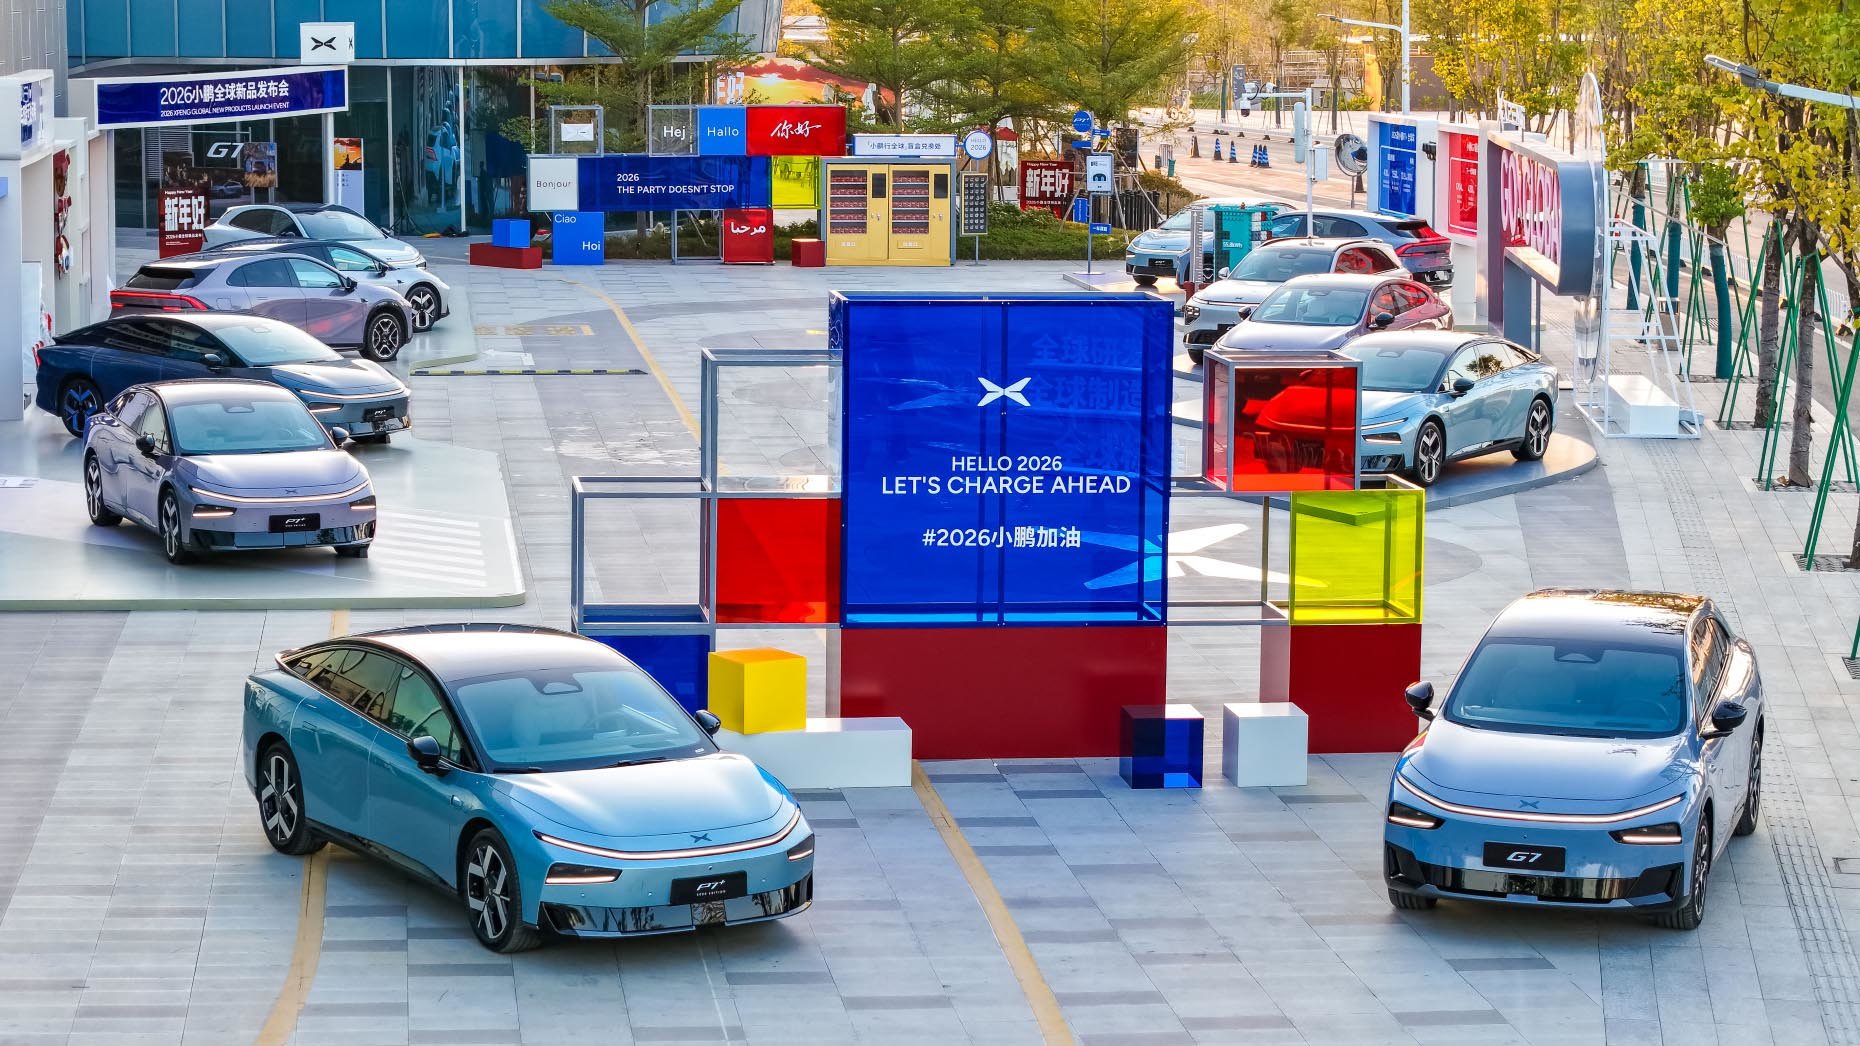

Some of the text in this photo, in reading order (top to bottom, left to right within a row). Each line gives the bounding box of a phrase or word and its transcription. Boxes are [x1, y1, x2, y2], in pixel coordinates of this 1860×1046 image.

[160, 79, 289, 105] 2026小鹏全球新品发布会
[192, 107, 212, 115] GLOBAL
[212, 106, 225, 114] NEW
[225, 105, 251, 113] PRODUCTS
[252, 103, 273, 111] LAUNCH
[663, 125, 686, 141] Hej
[707, 126, 739, 137] Hallo
[770, 119, 822, 140] 你好
[206, 142, 244, 158] G7
[536, 180, 572, 189] Bonjour
[616, 173, 640, 182] 2026
[1025, 168, 1069, 198] 新年好
[617, 184, 734, 194] THE PARTY DOESN'T STOP
[164, 195, 205, 231] 新年好
[554, 214, 577, 223] Ciao
[729, 221, 767, 236] مرحبا
[582, 240, 601, 251] Hoi
[951, 456, 1063, 472] HELLO 2026
[882, 476, 1131, 495] LET'S CHARGE AHEAD
[922, 526, 1081, 548] #2026小鹏加油
[1506, 851, 1543, 863] G7
[696, 879, 726, 892] P7+
